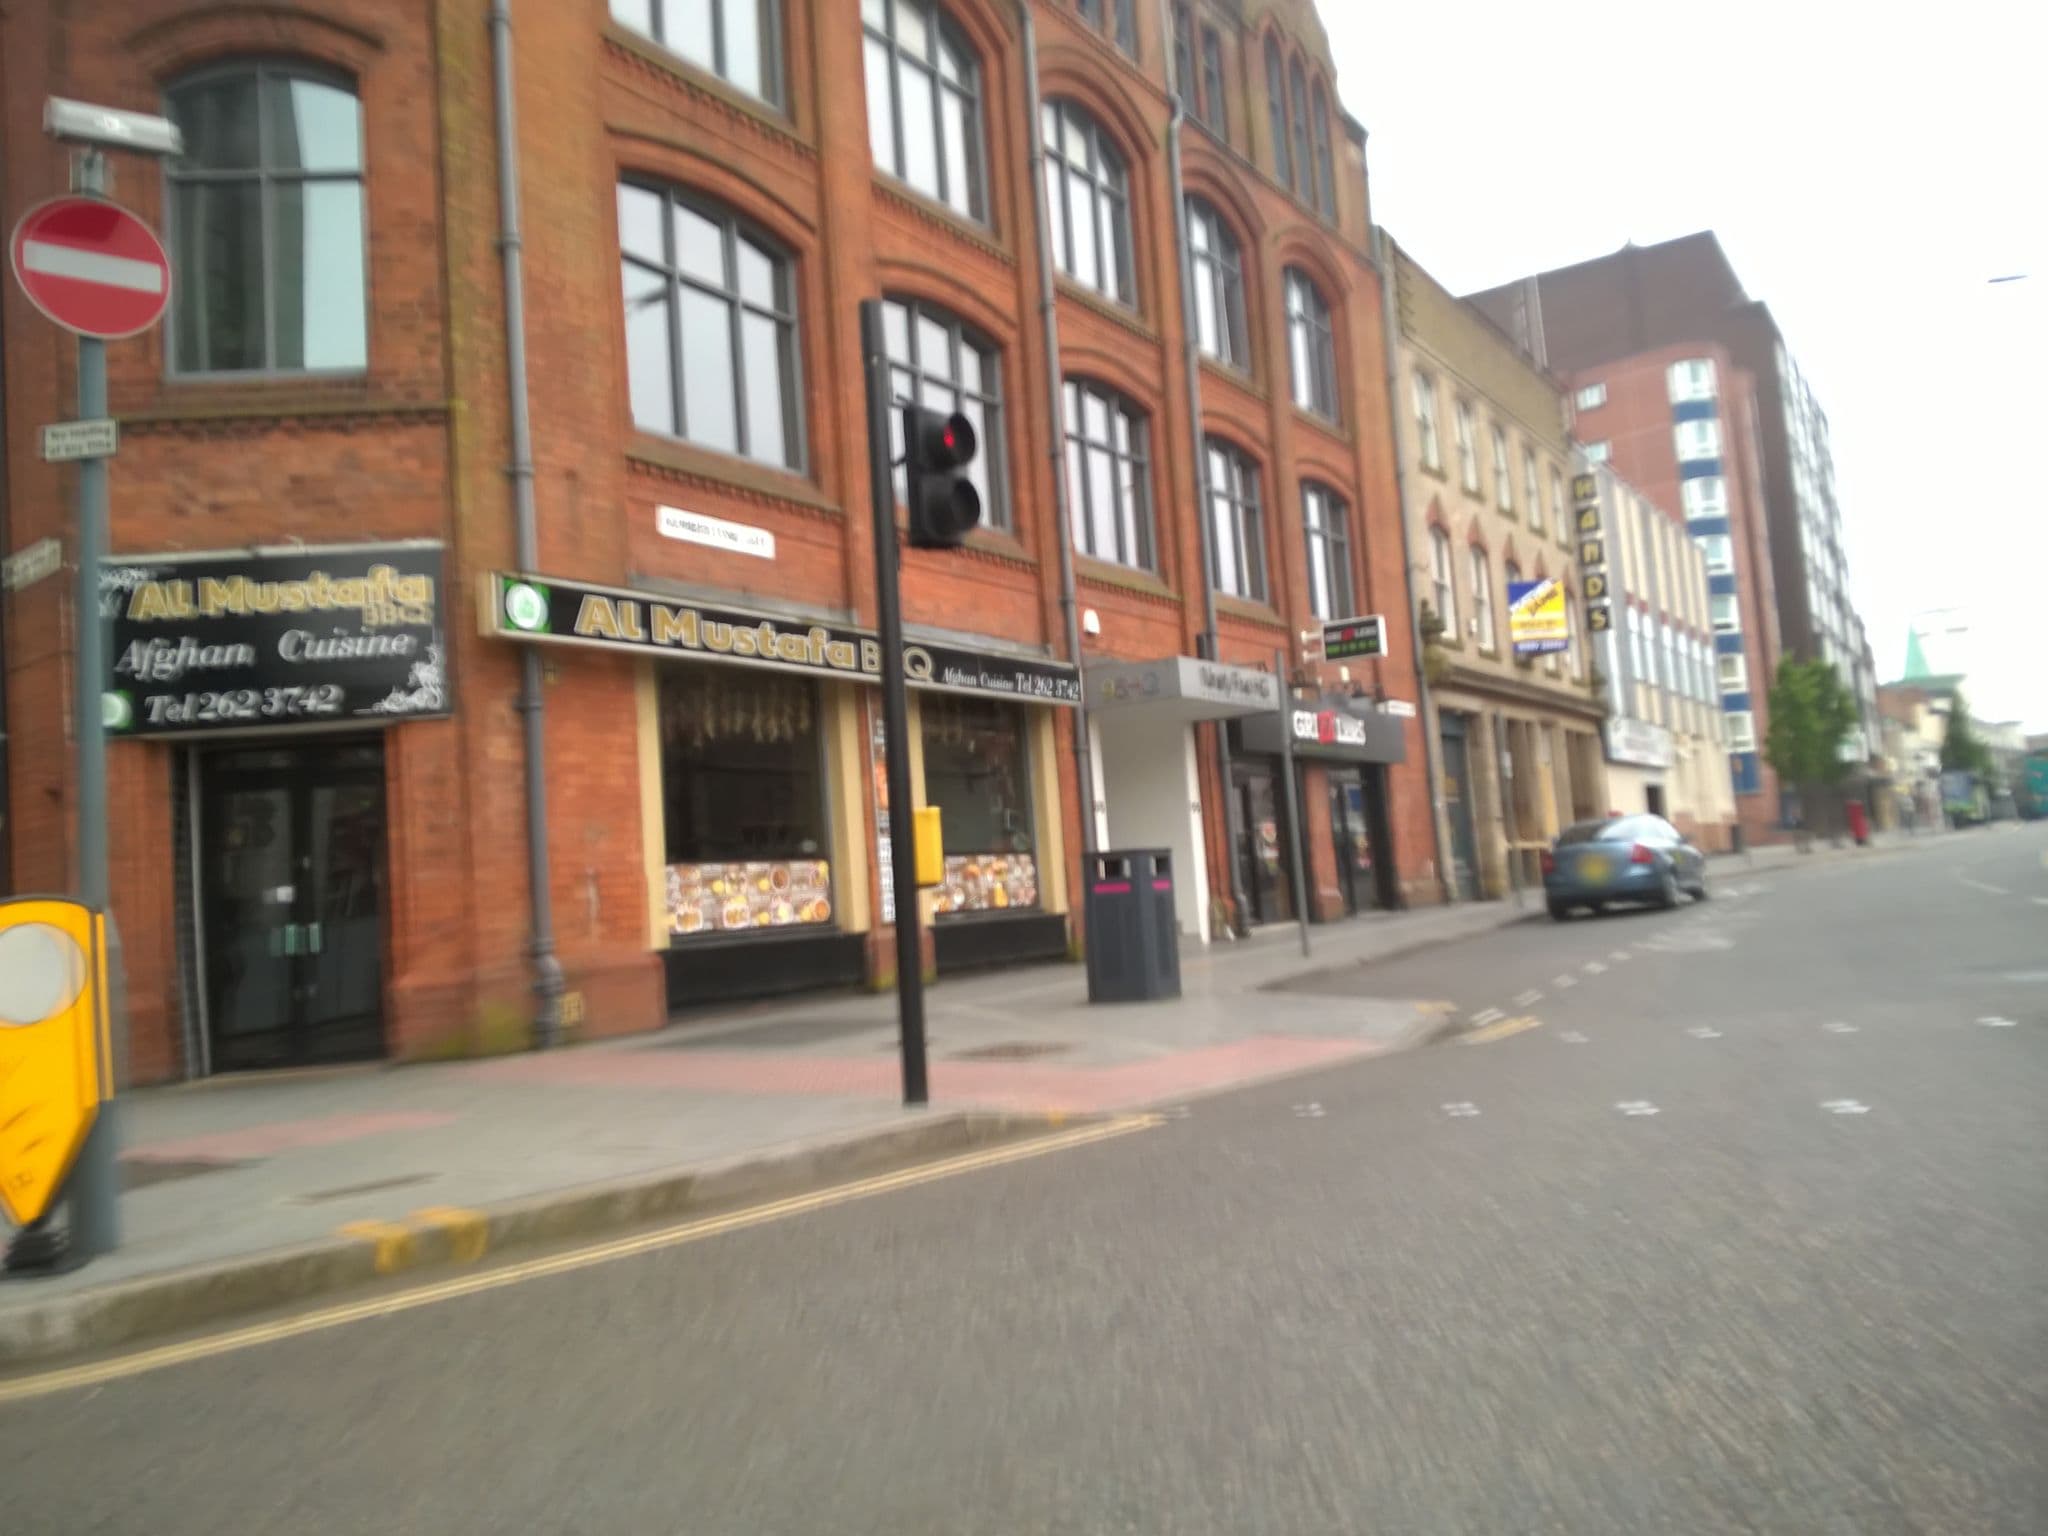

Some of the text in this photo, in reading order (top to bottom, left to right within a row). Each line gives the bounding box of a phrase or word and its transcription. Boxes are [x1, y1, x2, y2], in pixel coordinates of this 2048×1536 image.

[199, 564, 434, 617] Mustafa
[362, 602, 433, 626] BBQ
[114, 625, 417, 682] Afghan Cuisine
[649, 603, 858, 670] Mustafa
[861, 638, 935, 683] BQ
[145, 684, 344, 724] Tel 262 3742
[1014, 671, 1033, 694] Tel
[1033, 675, 1054, 697] 262
